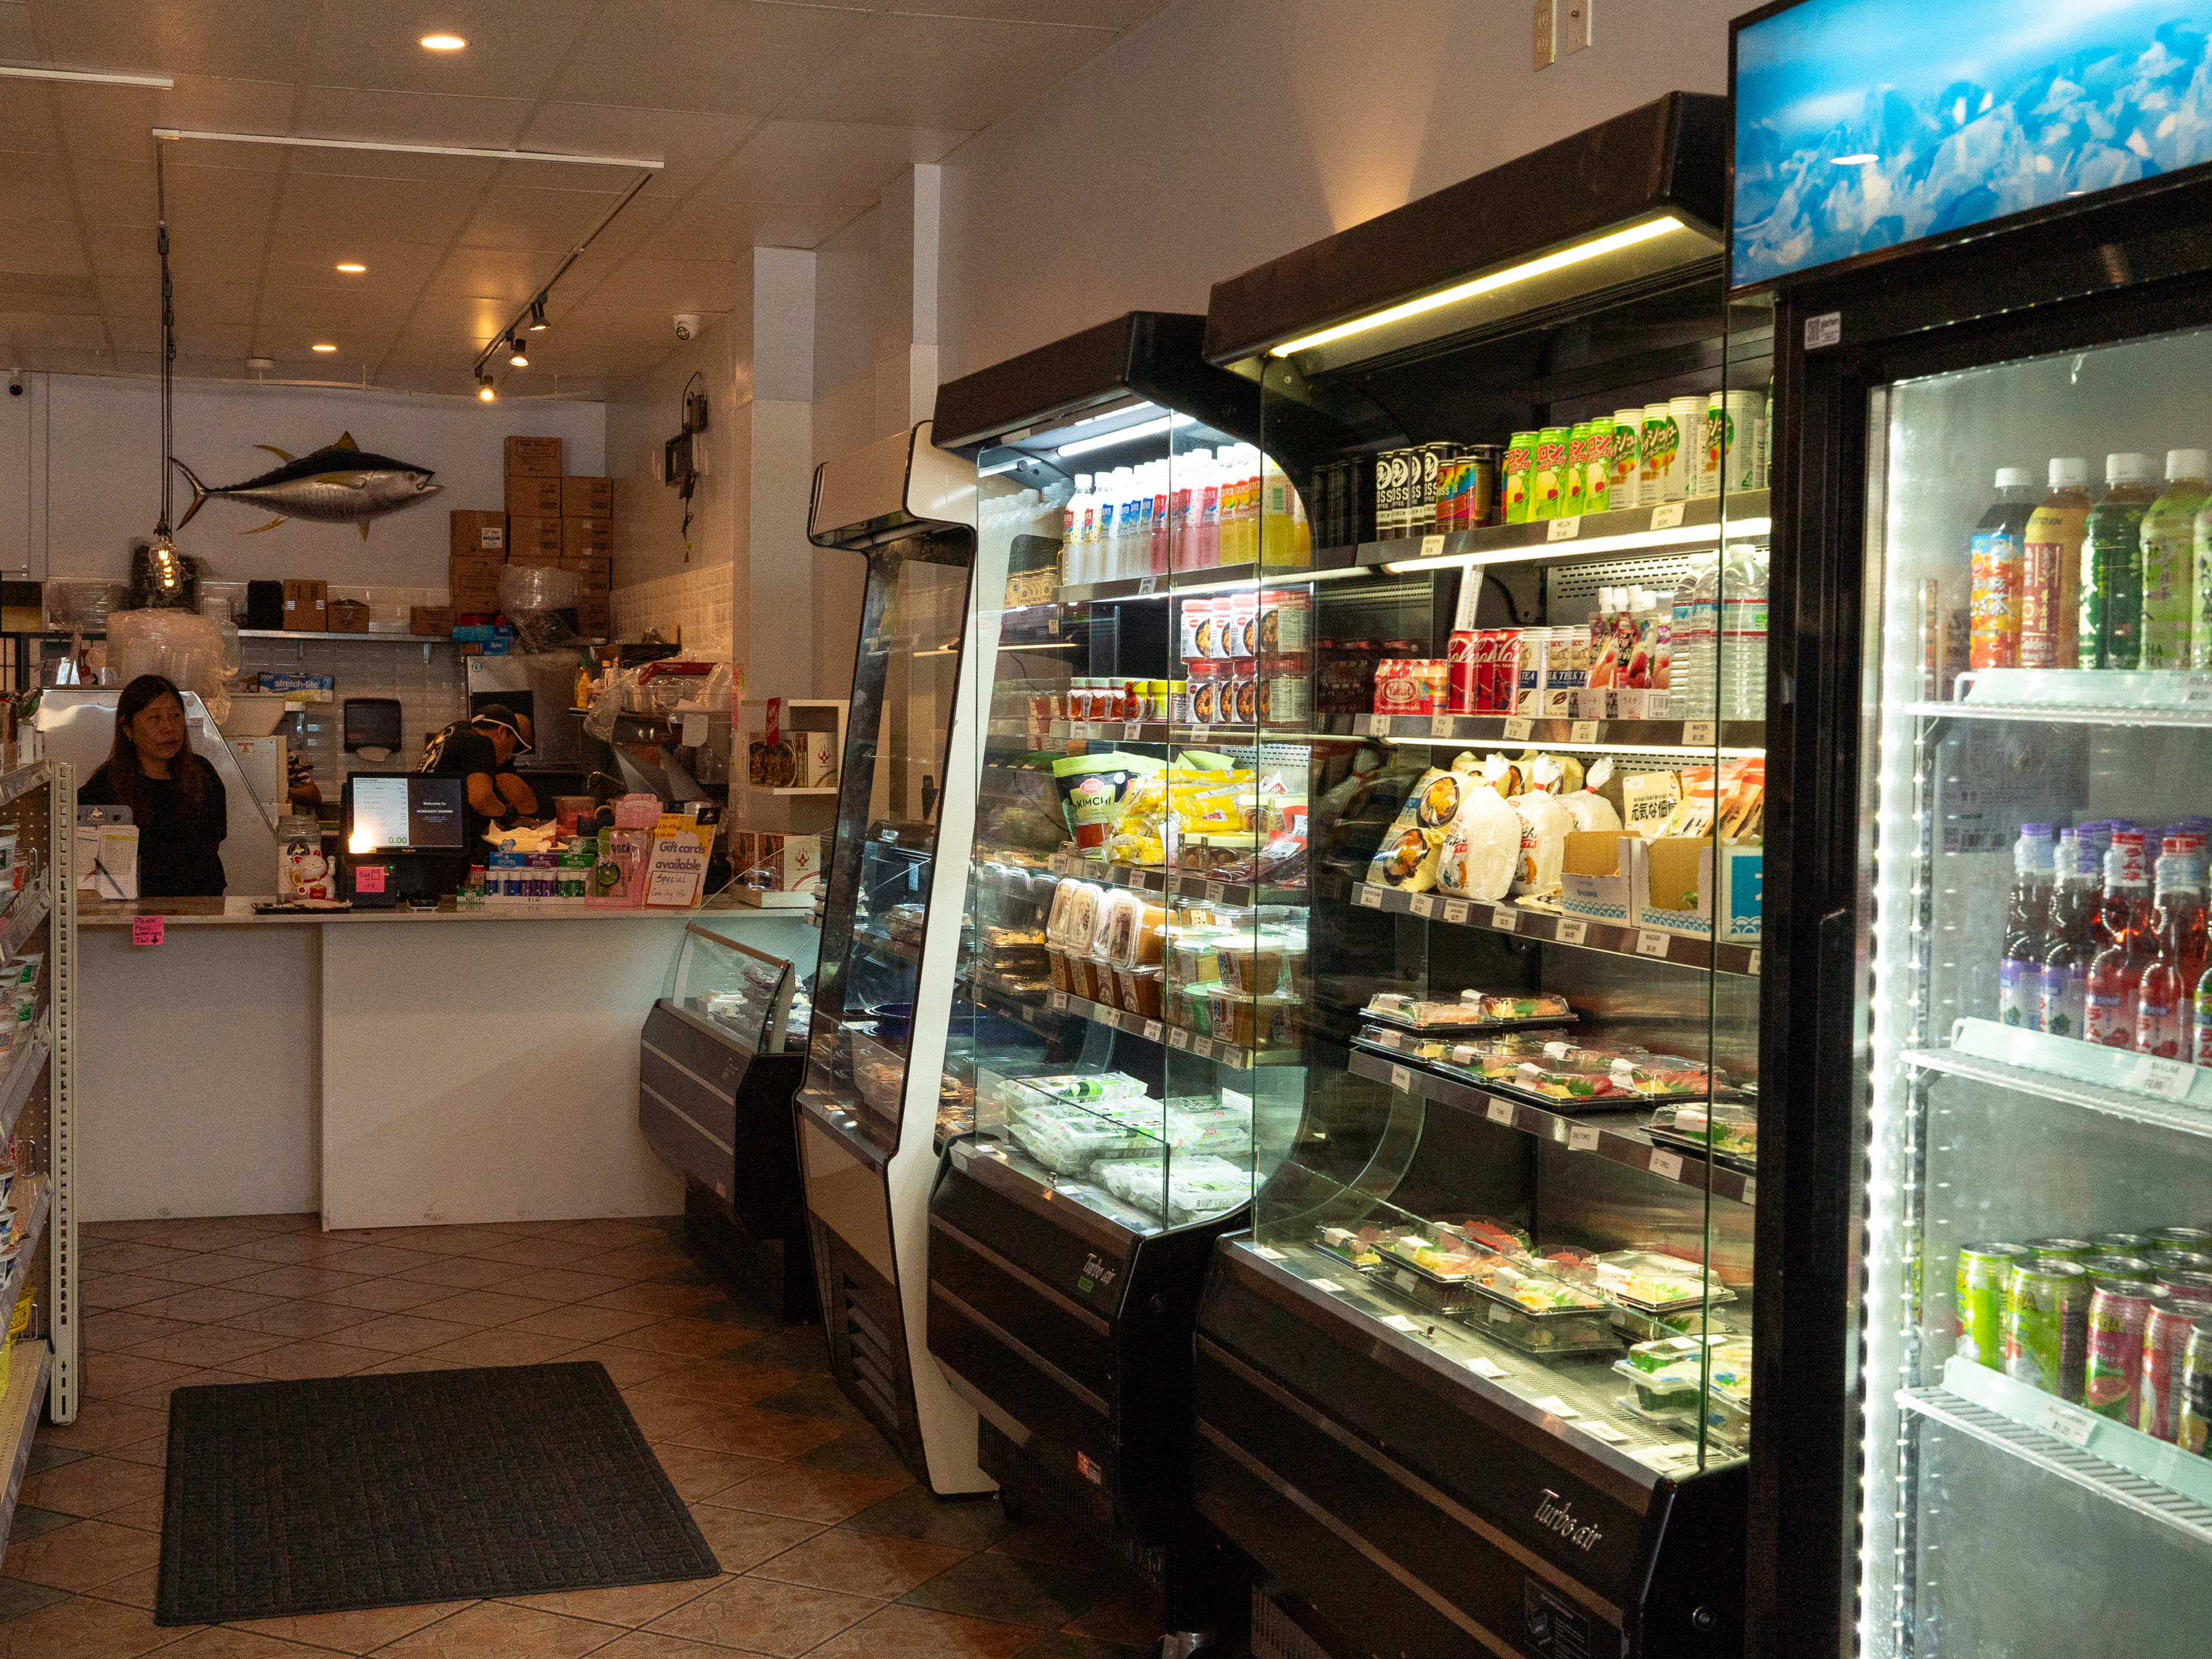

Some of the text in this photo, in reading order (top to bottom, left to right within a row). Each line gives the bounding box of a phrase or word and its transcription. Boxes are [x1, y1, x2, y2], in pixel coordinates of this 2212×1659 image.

[275, 680, 319, 689] stretch-tite
[1389, 685, 1412, 698] Yakult
[1076, 796, 1111, 809] KIMCHI
[660, 841, 706, 854] Gift cards
[656, 858, 701, 870] available
[656, 873, 687, 885] Special
[1083, 1253, 1104, 1279] Turbo
[1533, 1488, 1603, 1551] Turbo air
